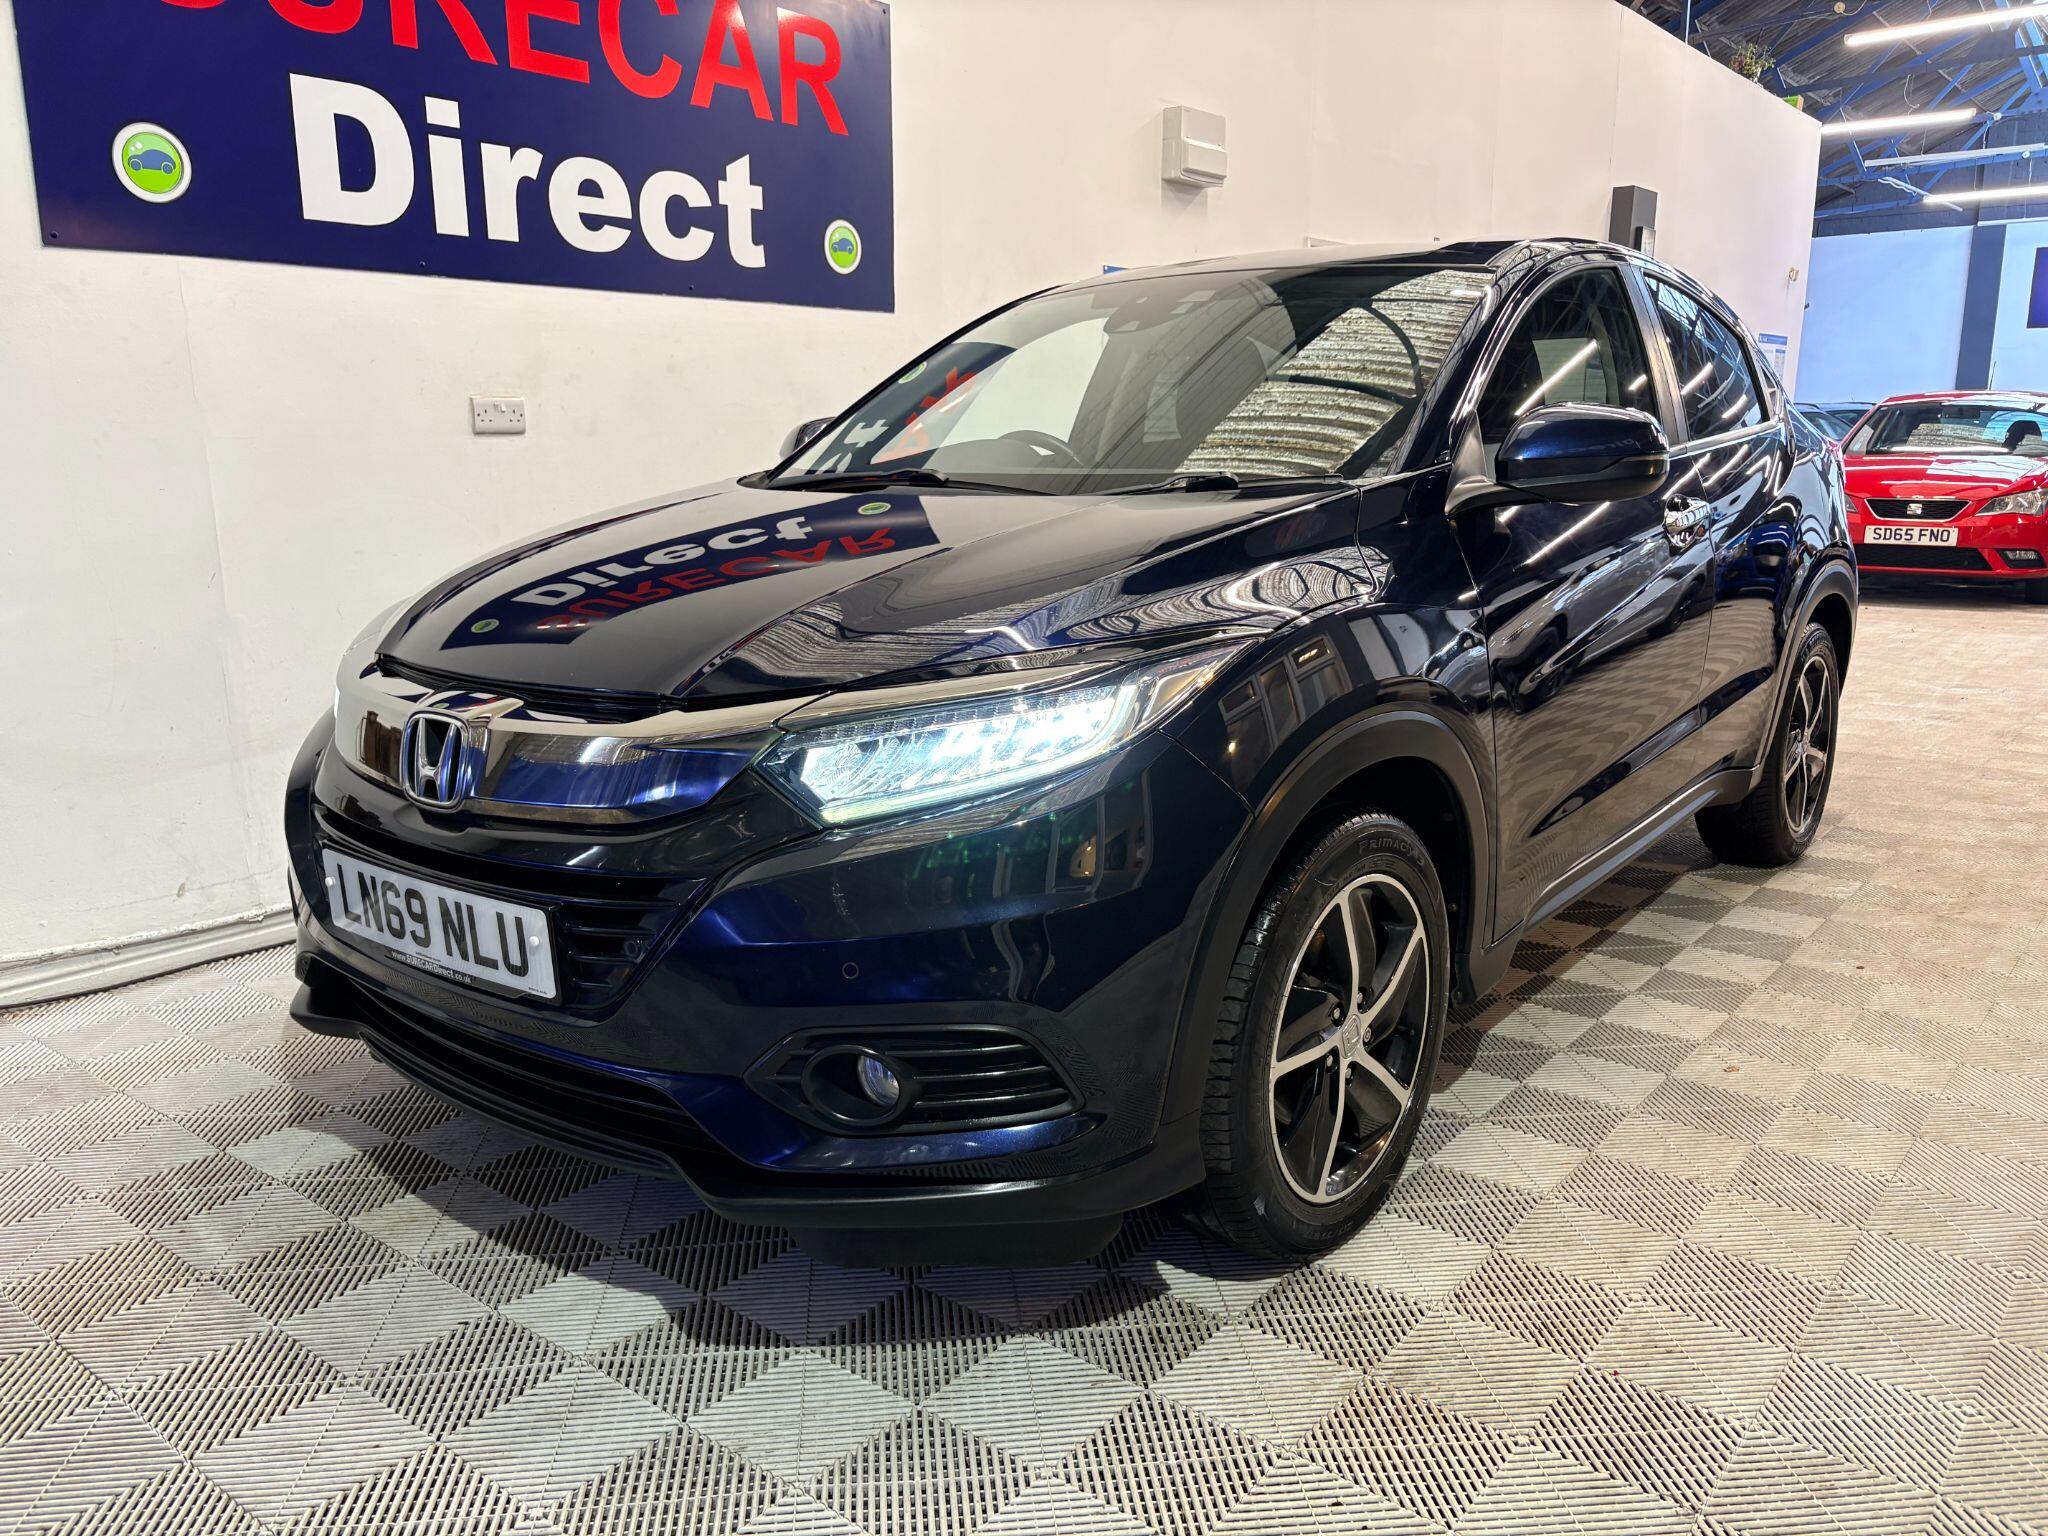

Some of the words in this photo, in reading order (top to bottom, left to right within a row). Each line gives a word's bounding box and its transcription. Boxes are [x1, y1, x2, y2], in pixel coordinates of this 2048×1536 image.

[161, 0, 849, 135] ECAR
[289, 72, 766, 268] Direct
[1872, 527, 1914, 542] SD65
[1918, 528, 1951, 542] FNO
[337, 864, 431, 949] LN69
[437, 896, 529, 978] NLU
